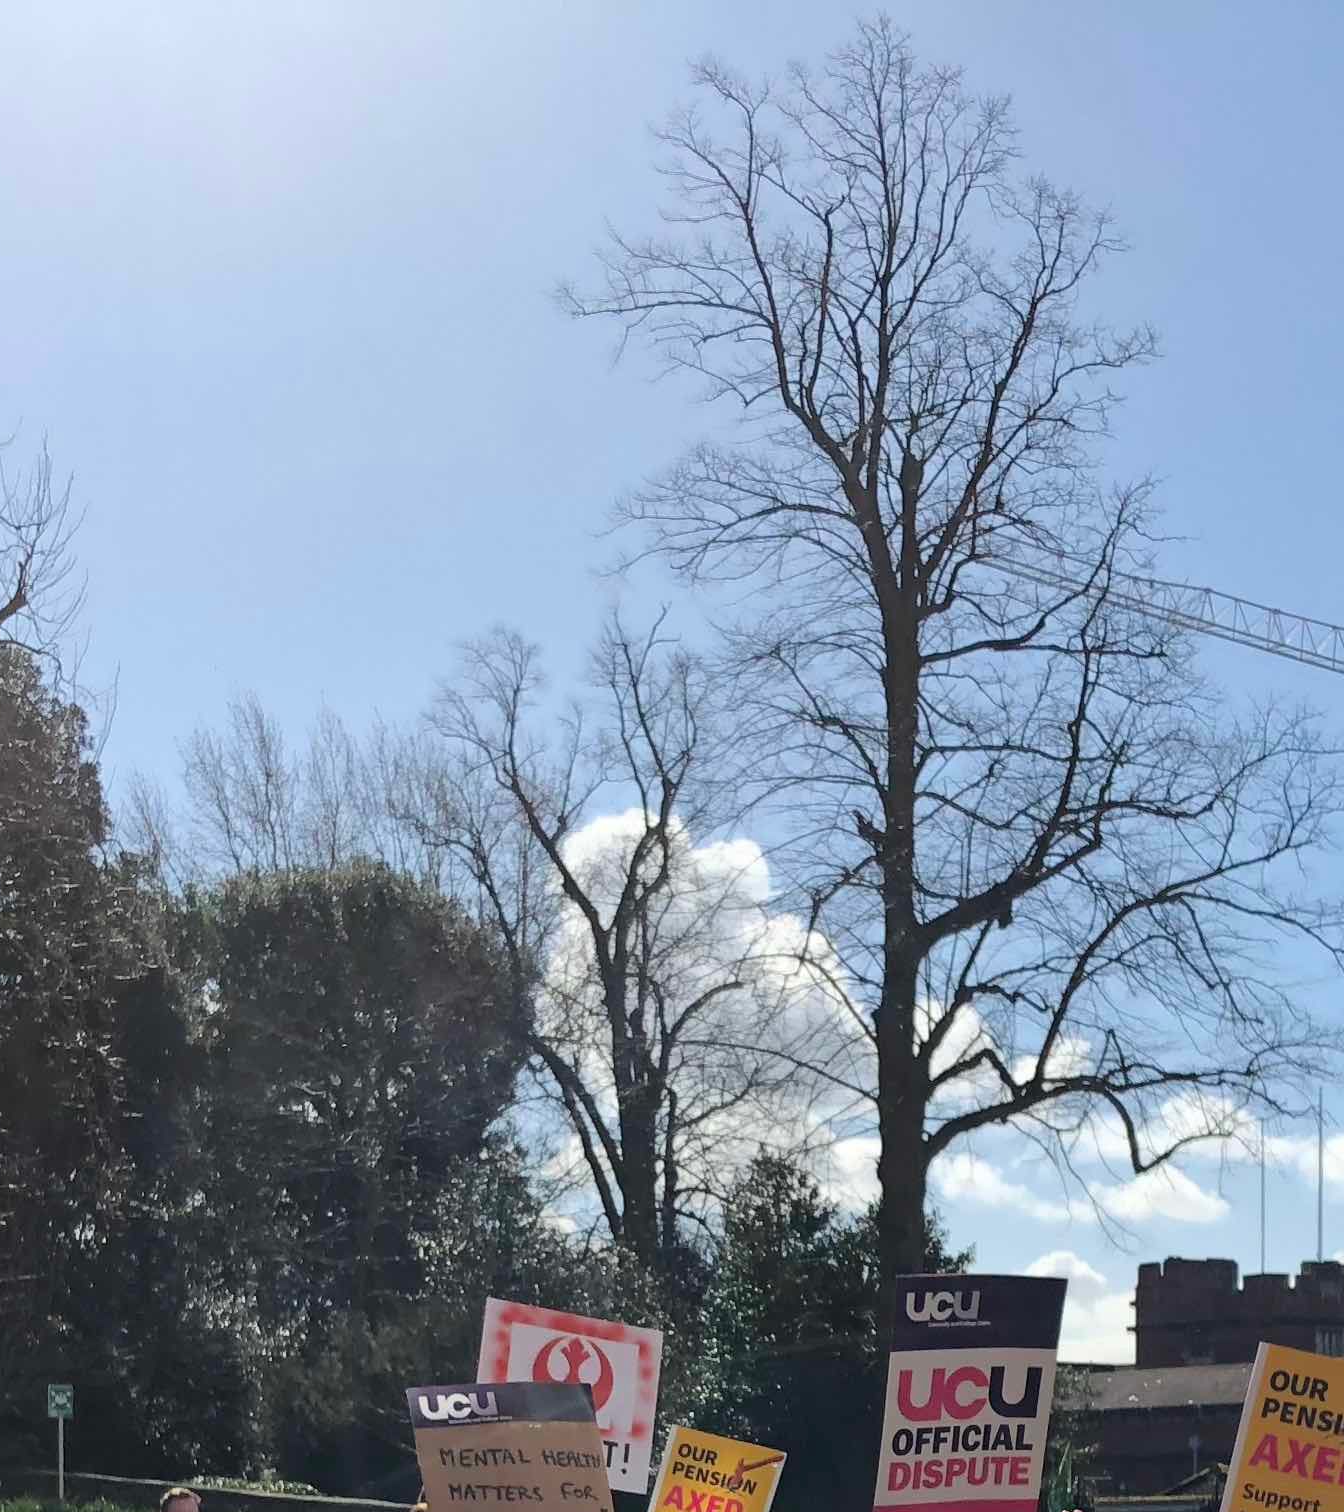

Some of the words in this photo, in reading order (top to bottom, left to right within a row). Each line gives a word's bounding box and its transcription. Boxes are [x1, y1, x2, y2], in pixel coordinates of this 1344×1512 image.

[897, 1366, 1043, 1422] UCU
[1269, 1370, 1329, 1402] OUR
[678, 1443, 719, 1466] OUR
[891, 1424, 1034, 1457] OFFICIAL
[440, 1449, 531, 1468] MENTAL
[542, 1450, 602, 1468] HEALTH
[887, 1456, 1033, 1491] DISPUTE
[449, 1483, 543, 1502] MATTERS
[672, 1461, 758, 1496] PENSION
